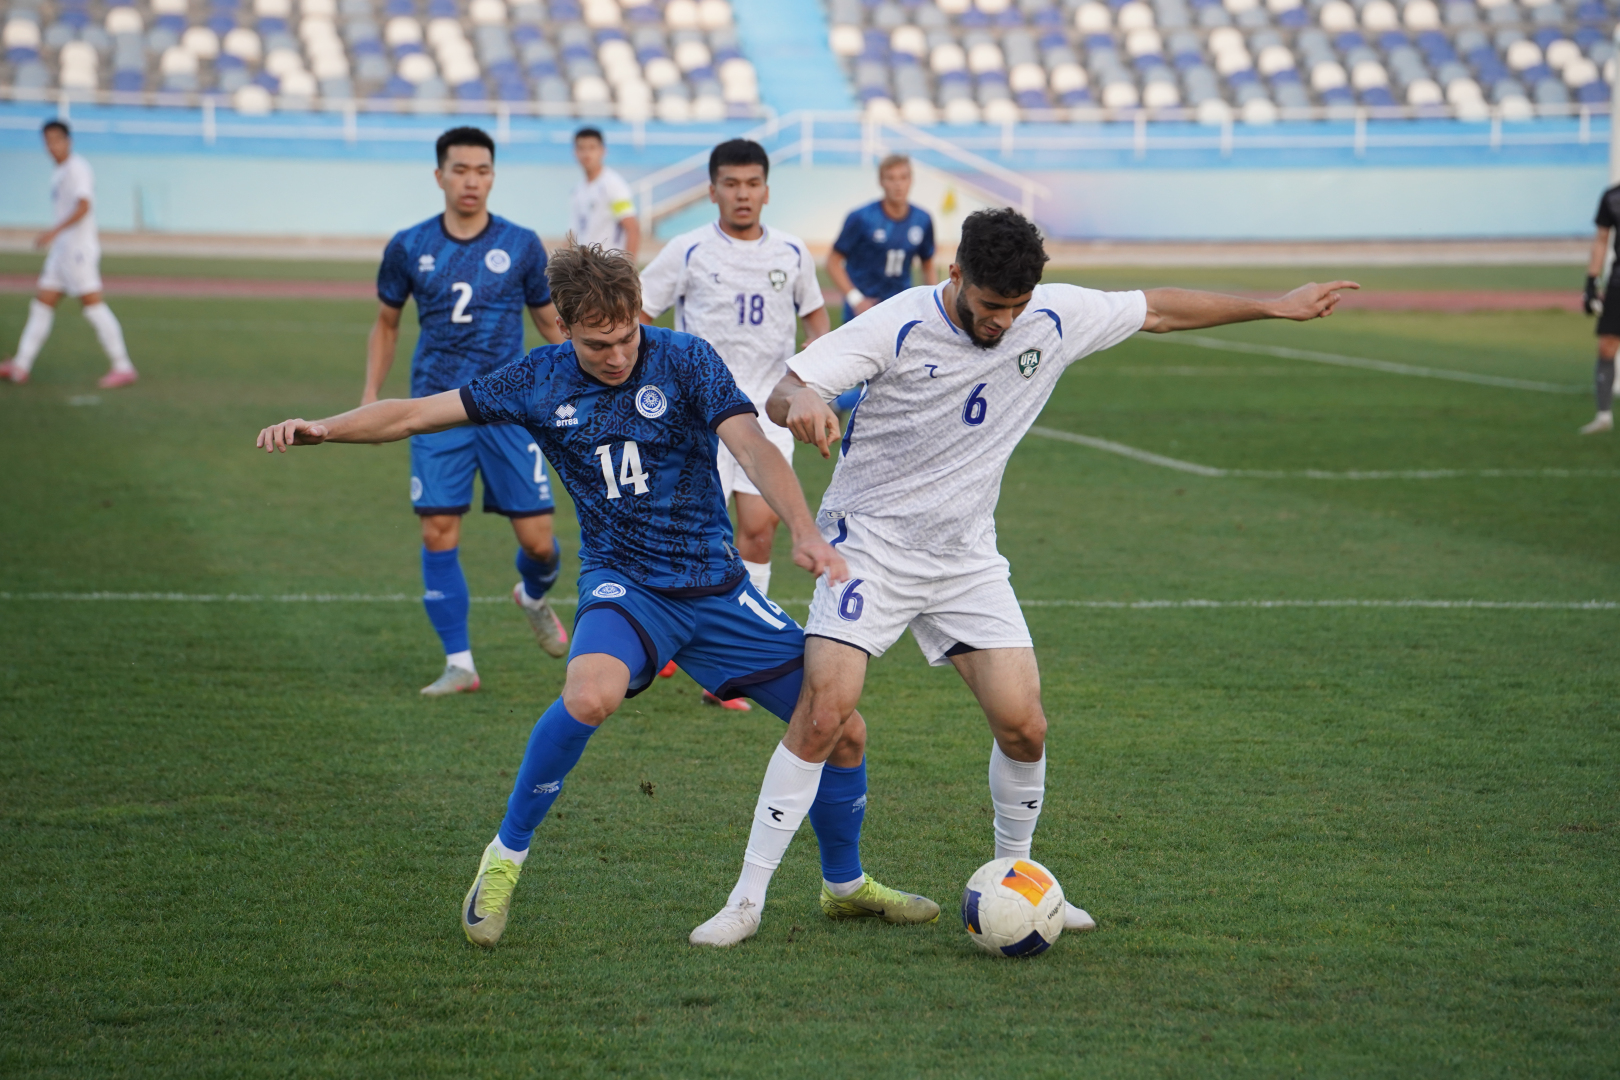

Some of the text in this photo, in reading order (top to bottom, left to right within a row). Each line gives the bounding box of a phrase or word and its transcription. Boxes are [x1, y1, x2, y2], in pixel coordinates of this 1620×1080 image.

[451, 282, 473, 323] 2
[735, 294, 764, 325] 18
[1020, 353, 1038, 365] UFA
[962, 383, 987, 426] 6
[594, 441, 650, 499] 14
[838, 579, 864, 621] 6
